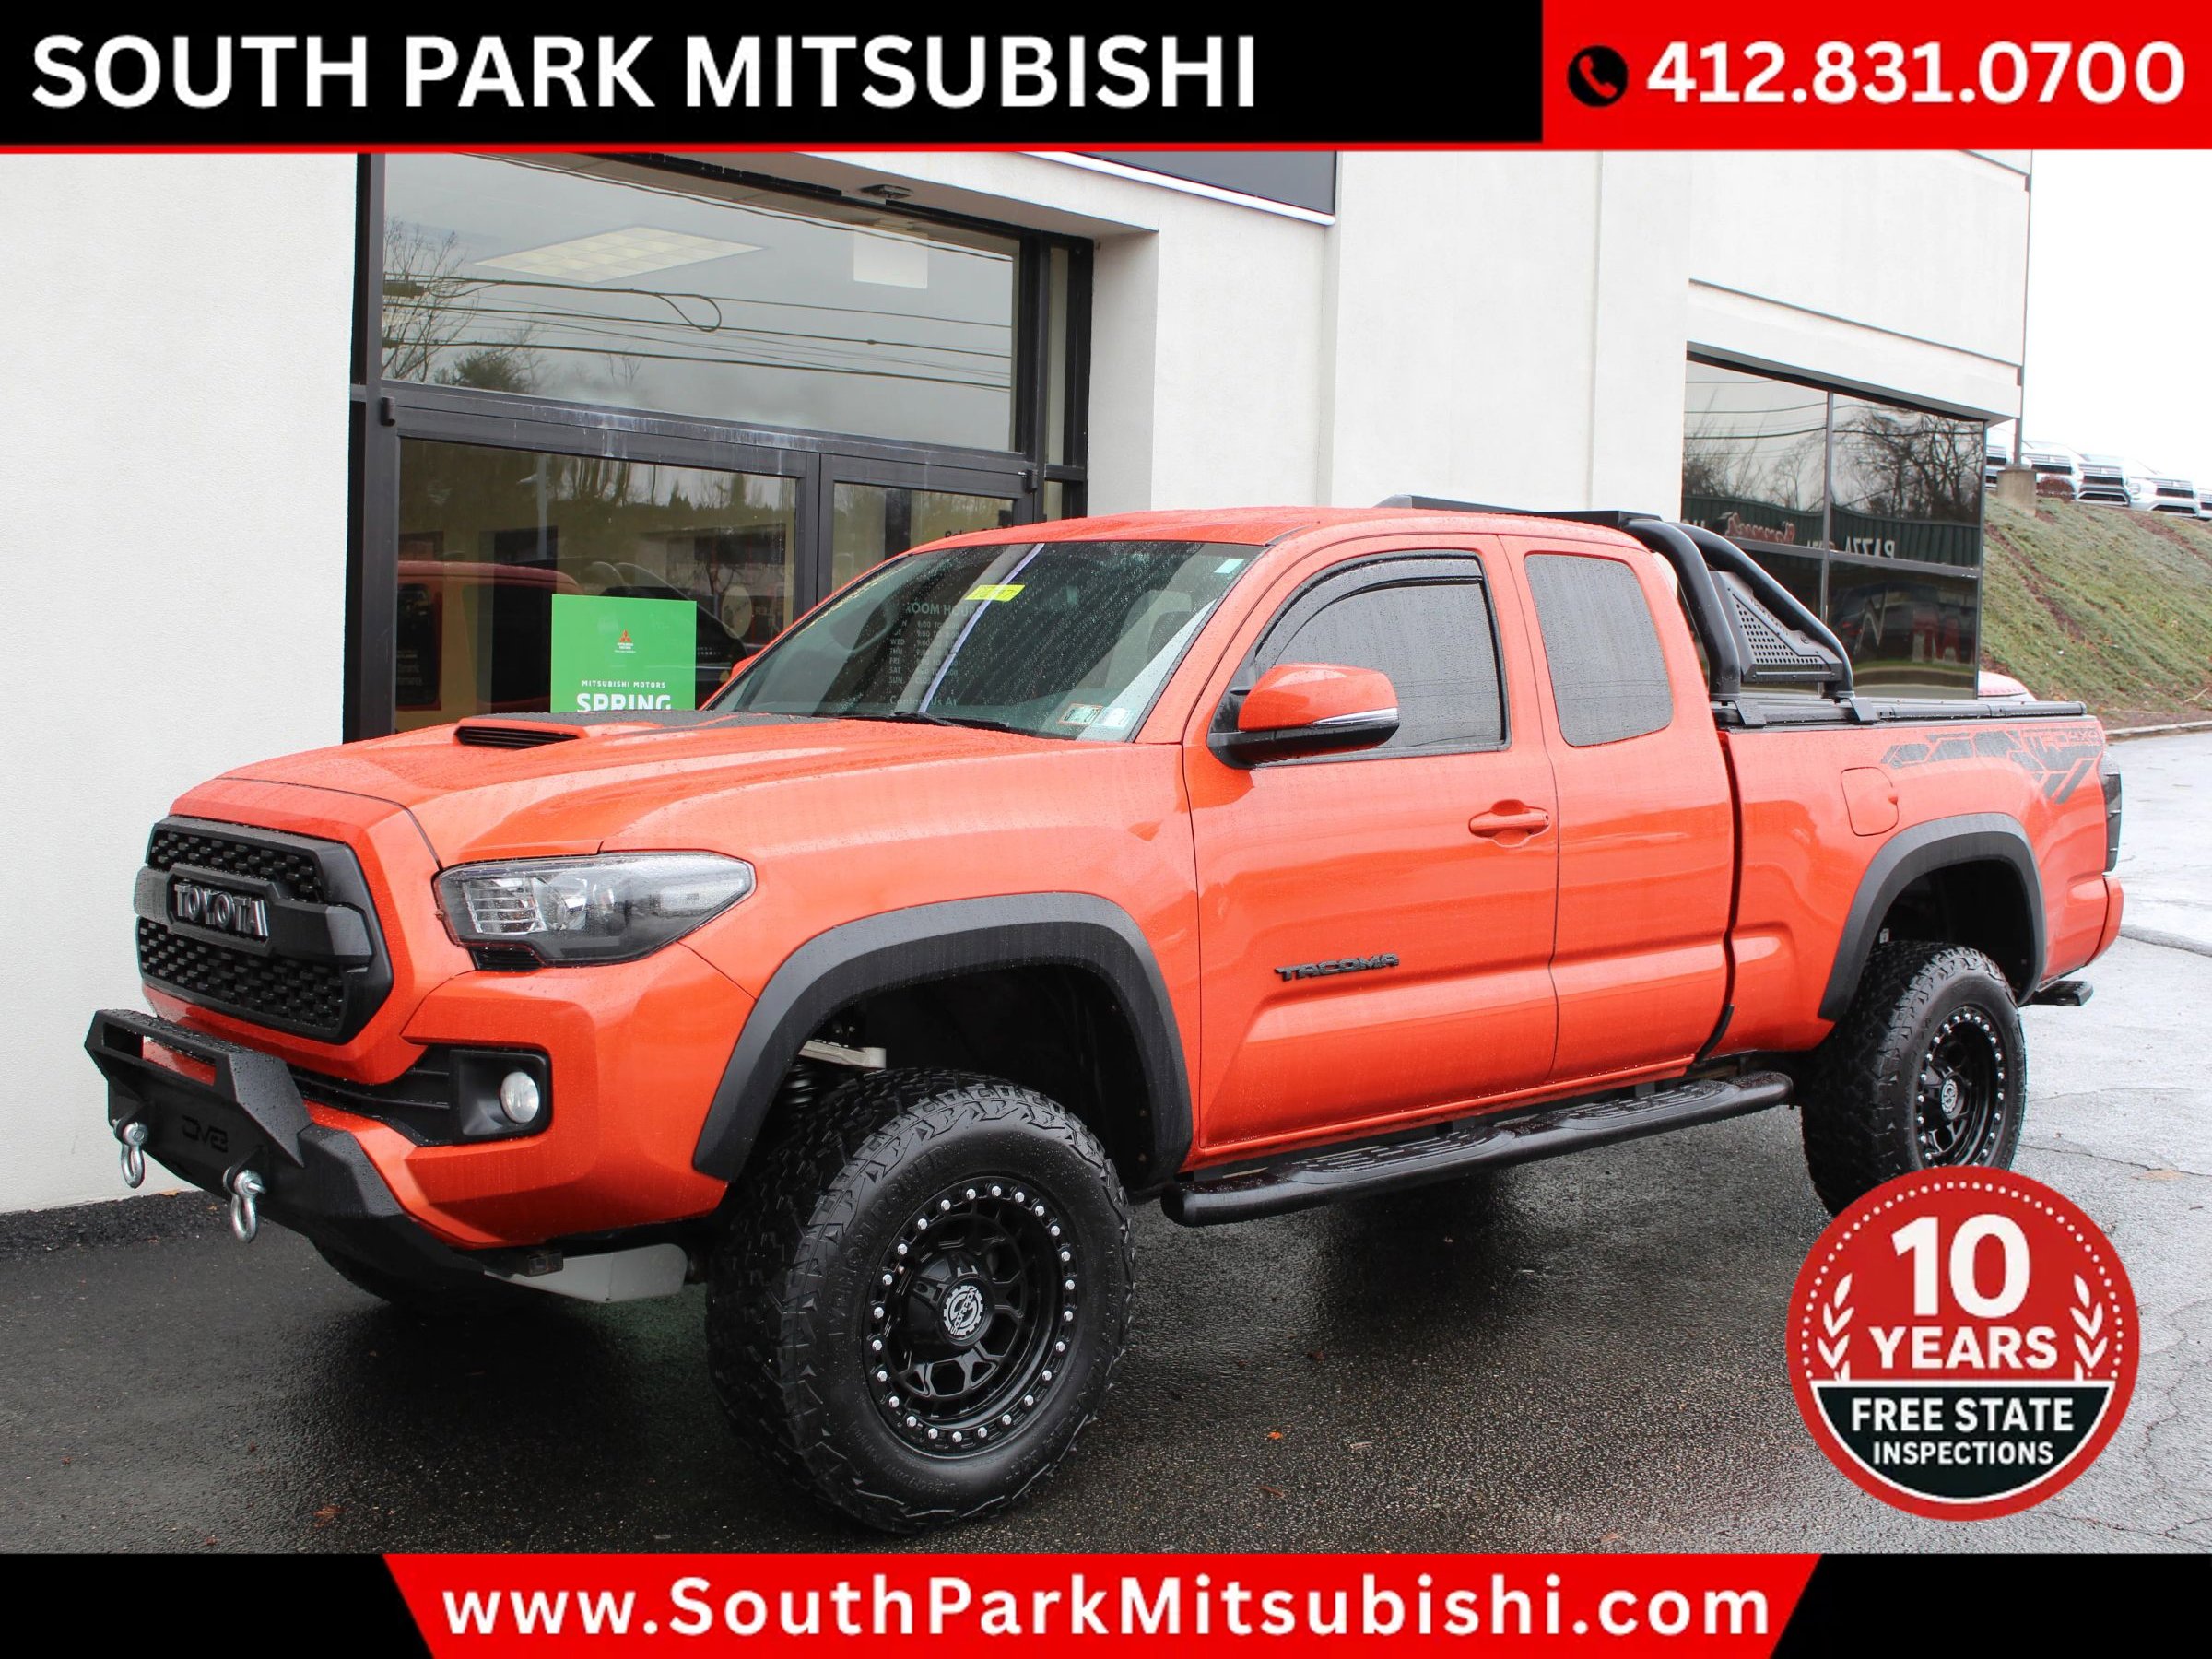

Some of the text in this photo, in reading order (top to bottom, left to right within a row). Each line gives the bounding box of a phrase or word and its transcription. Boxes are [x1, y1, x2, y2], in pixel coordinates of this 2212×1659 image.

[576, 692, 671, 712] SPRING
[173, 882, 270, 937] TOYOTA
[1275, 952, 1399, 982] TACOMA
